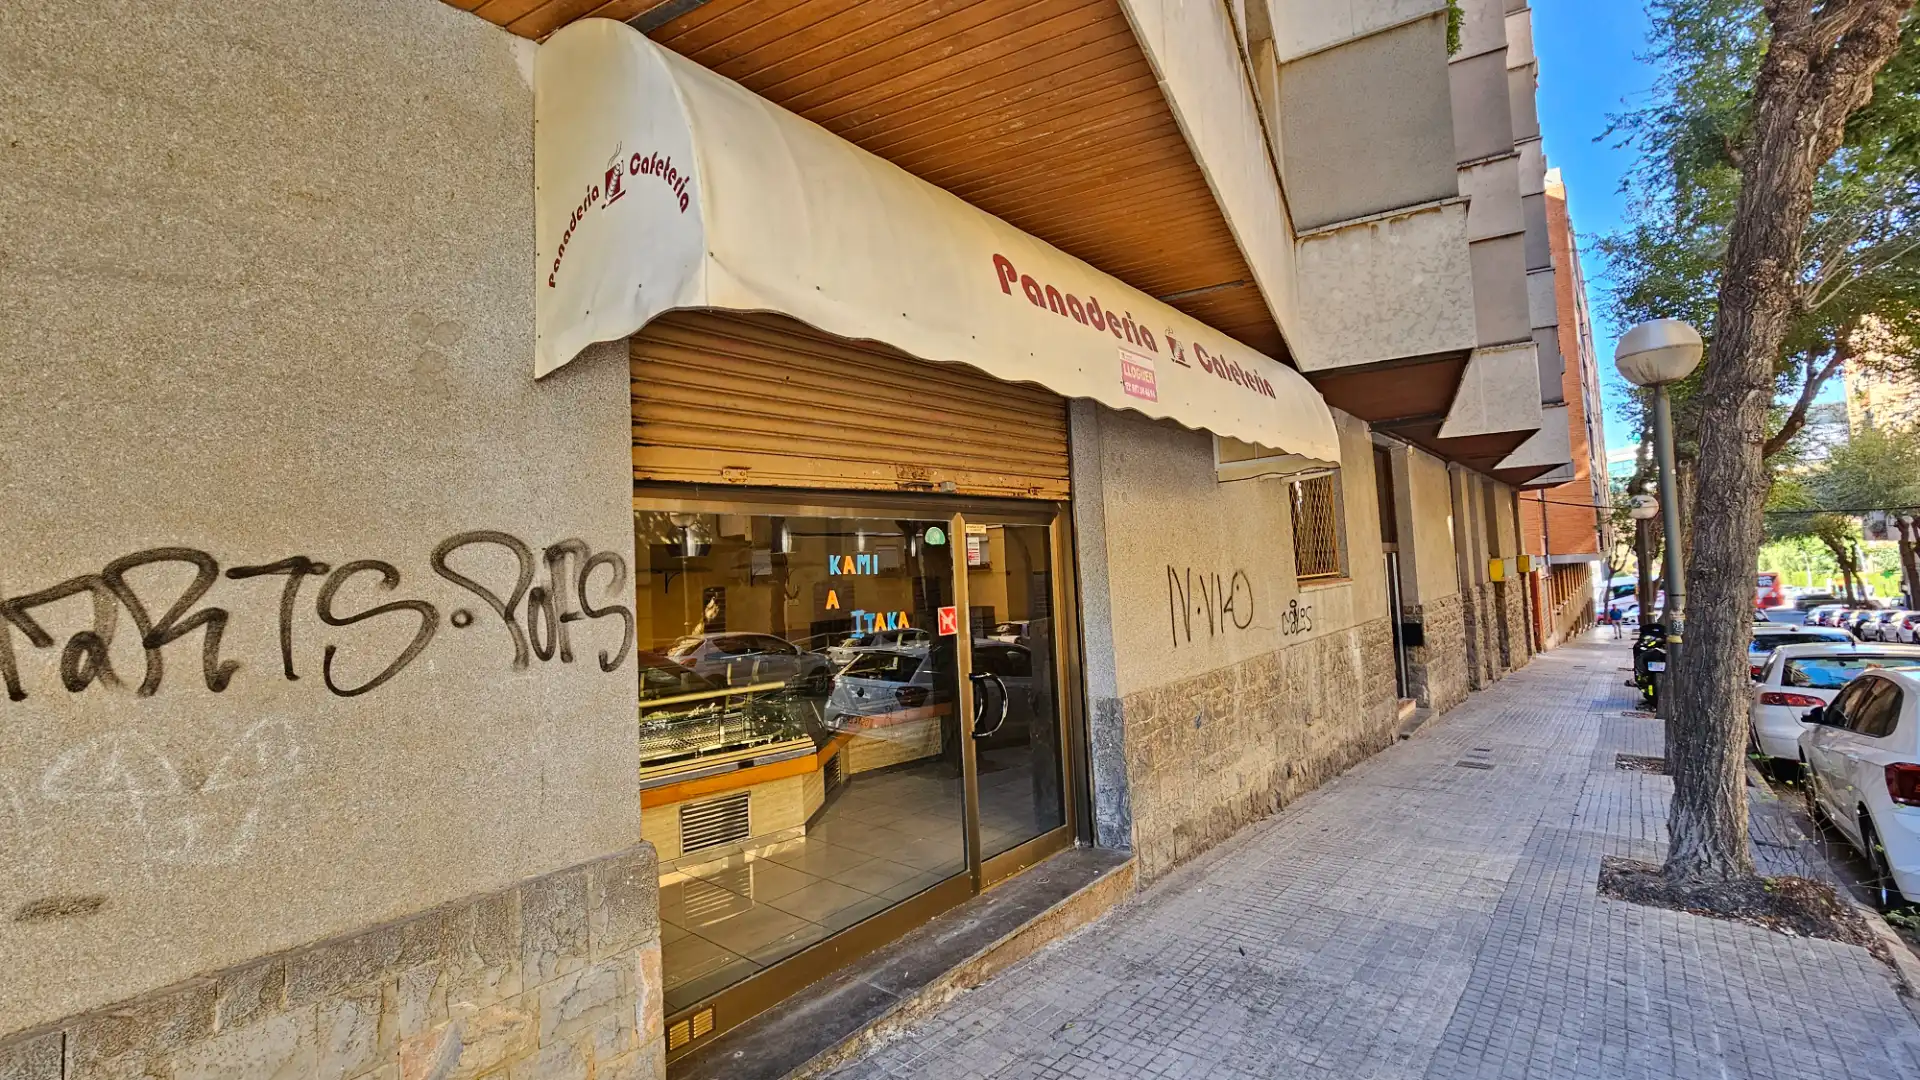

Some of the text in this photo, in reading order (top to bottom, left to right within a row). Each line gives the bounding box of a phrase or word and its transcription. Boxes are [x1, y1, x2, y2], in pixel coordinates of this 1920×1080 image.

[829, 554, 879, 575] KAMI
[825, 590, 840, 610] A
[850, 609, 910, 639] ITAKA
